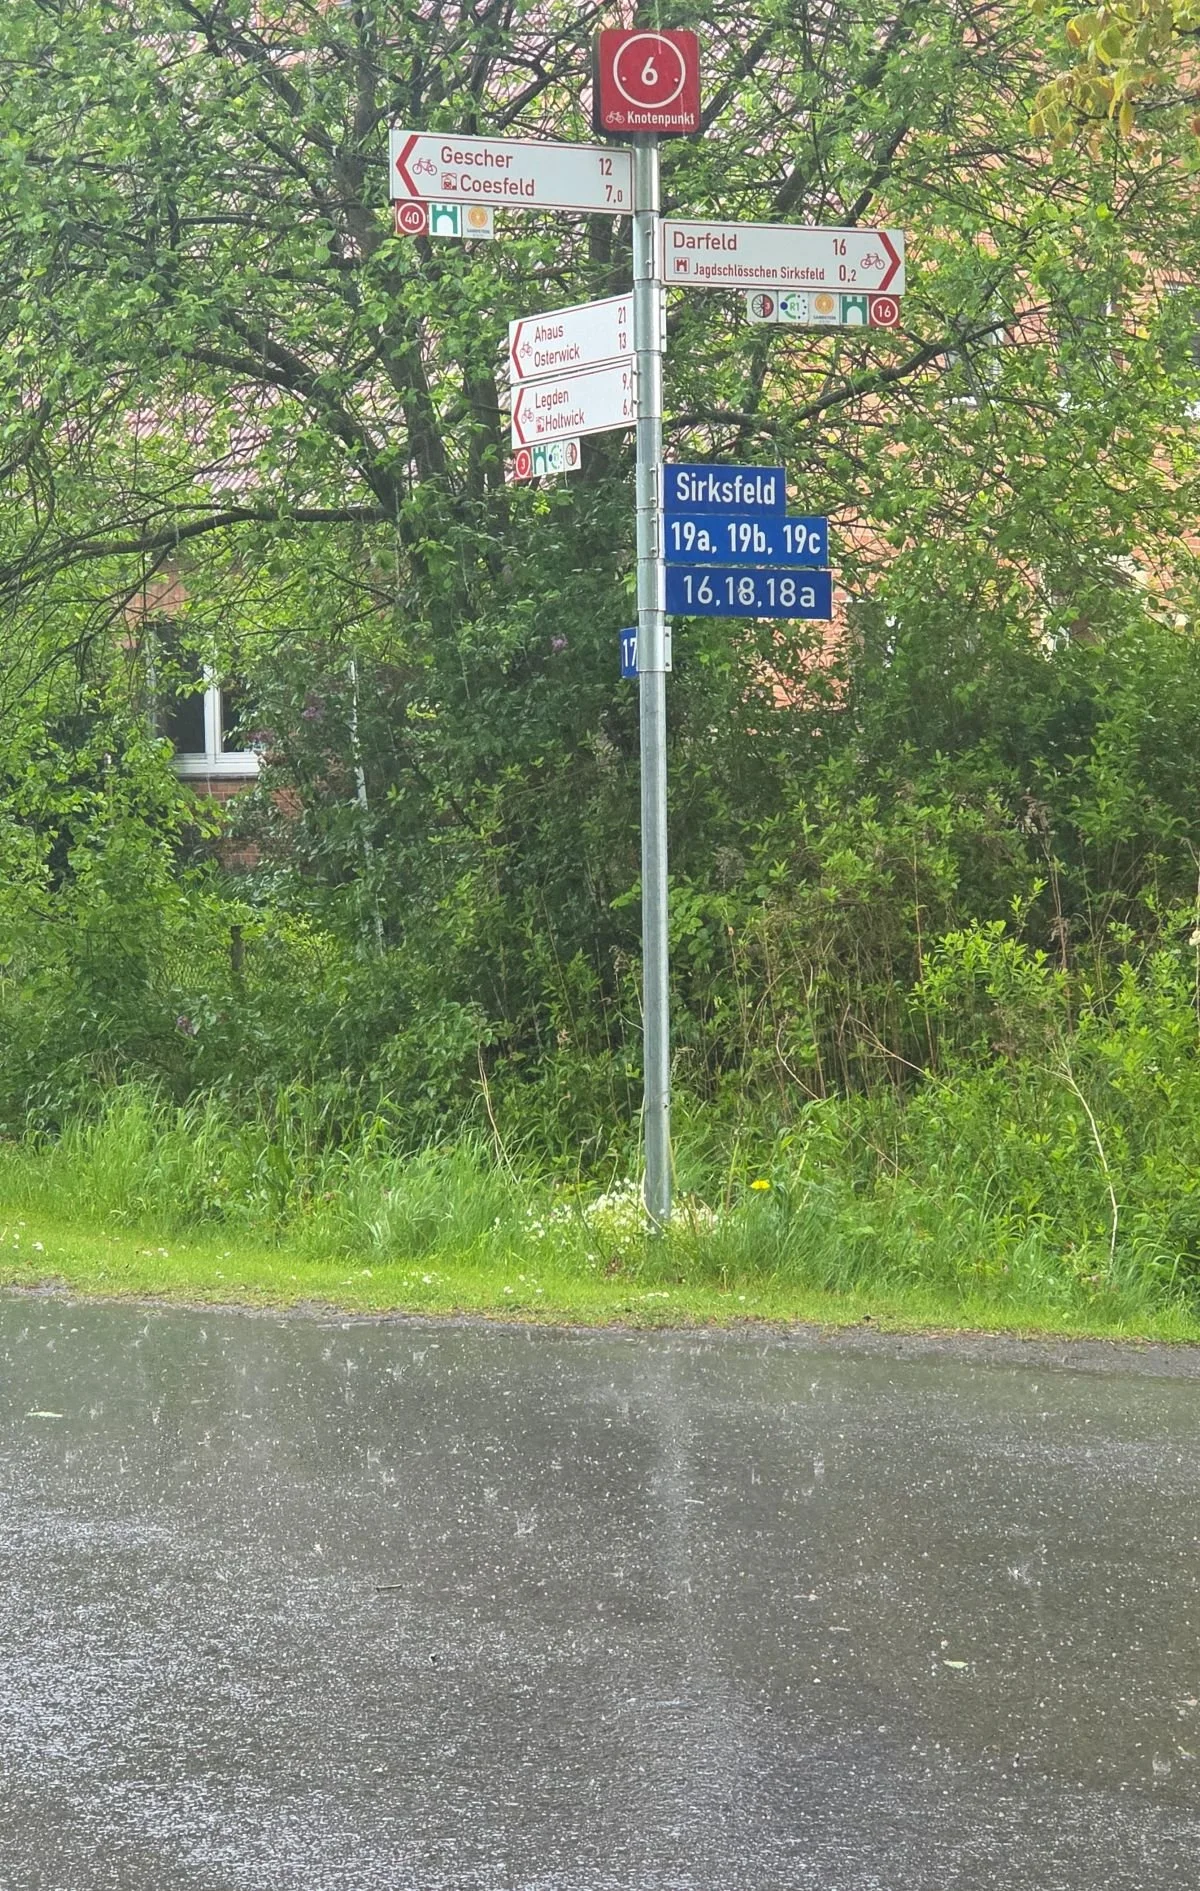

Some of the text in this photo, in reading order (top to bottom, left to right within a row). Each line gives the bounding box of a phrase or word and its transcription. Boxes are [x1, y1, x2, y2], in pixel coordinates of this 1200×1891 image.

[641, 56, 658, 86] 6
[627, 111, 694, 127] Knotenpunkt
[441, 146, 612, 176] Gescher 12
[460, 174, 623, 203] Coesfeld 7,0
[404, 211, 419, 225] 40
[673, 231, 847, 256] Darfeld 16
[694, 262, 857, 283] Jagdschlösschen Sirksfeld 0,2
[789, 302, 800, 312] R1
[877, 305, 891, 318] 16
[534, 306, 626, 343] Ahaus 21
[534, 332, 627, 367] Osterwick 13
[535, 388, 569, 411] Legden
[545, 408, 585, 432] Holtwick
[520, 457, 526, 470] 3
[676, 472, 776, 505] Sirksfeld
[671, 521, 821, 555] 19a, 19b, 19c
[623, 637, 637, 667] 17
